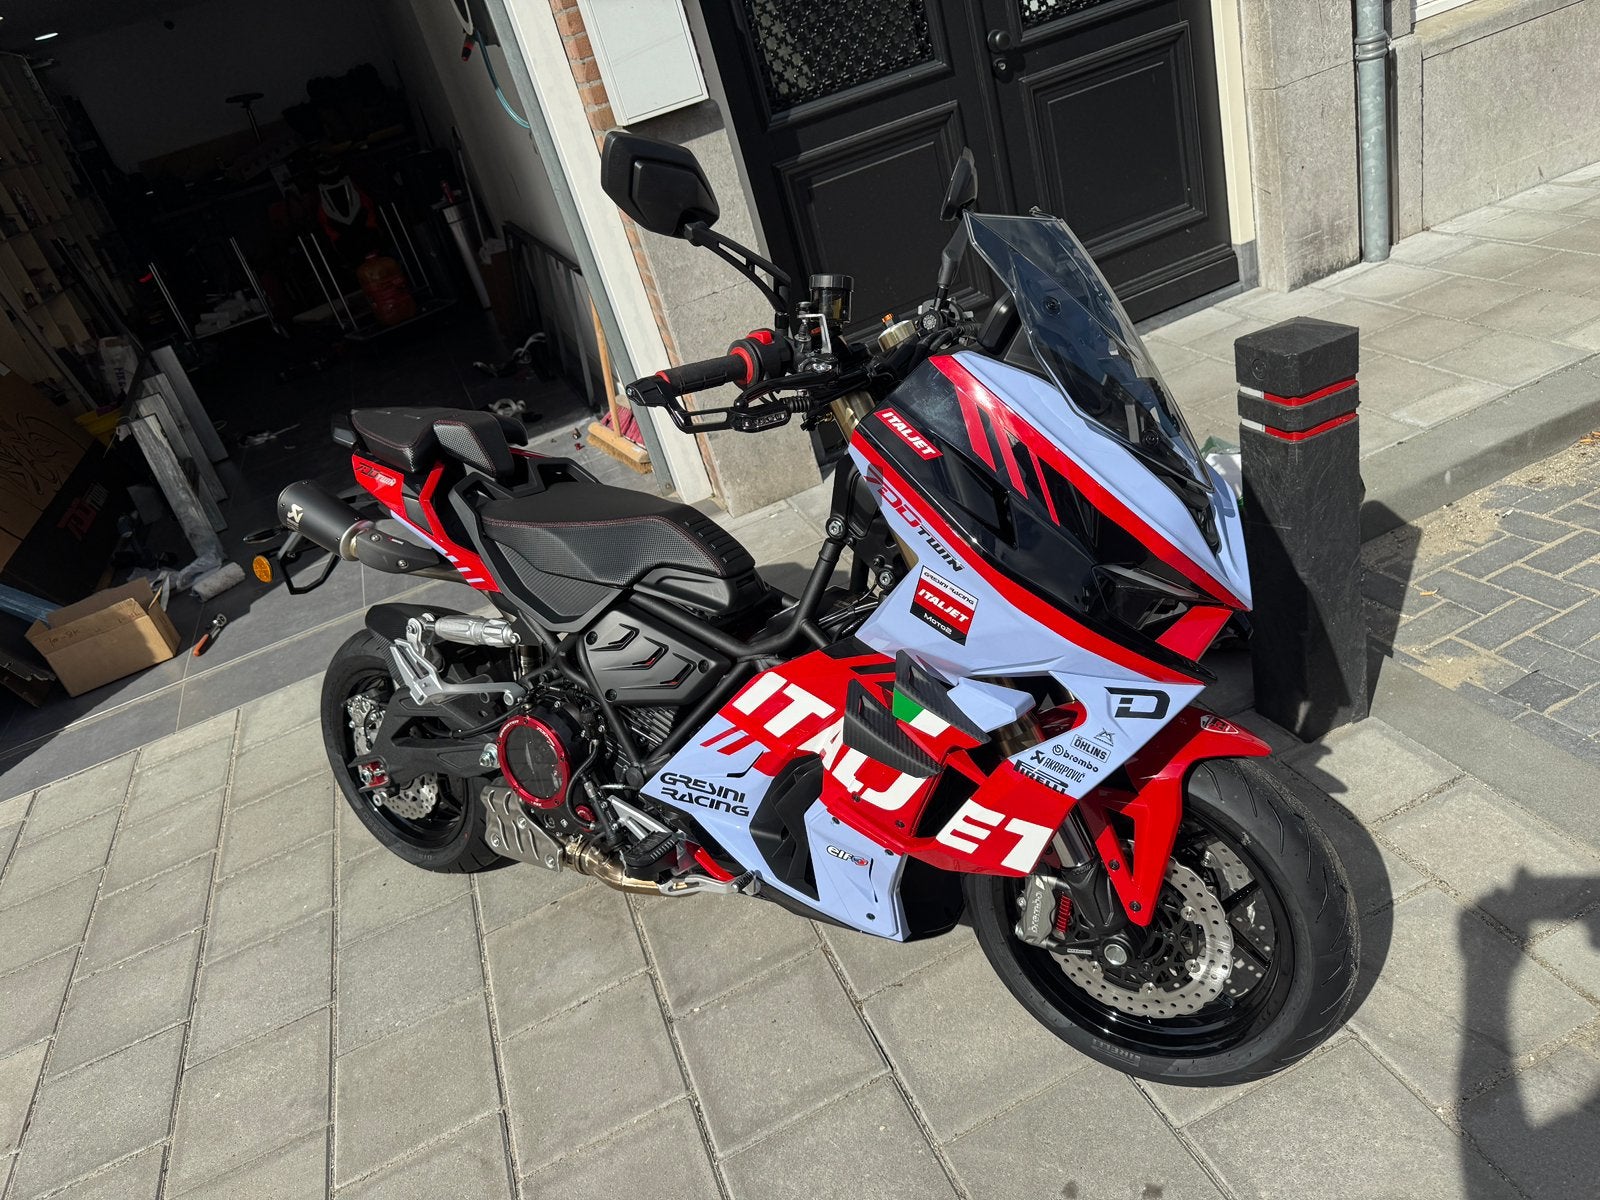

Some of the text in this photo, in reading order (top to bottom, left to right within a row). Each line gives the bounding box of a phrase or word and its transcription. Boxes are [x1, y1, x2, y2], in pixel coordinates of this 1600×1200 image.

[881, 411, 937, 456] ITALJET
[923, 571, 975, 606] GRESINI RACING
[917, 588, 969, 623] ITALJET
[1073, 737, 1108, 760] ÖHLINS
[660, 772, 745, 804] GRESINI
[1013, 759, 1069, 795] PIRELLI
[661, 786, 749, 818] RACING
[826, 845, 853, 861] elf
[1090, 1038, 1141, 1067] PIRELLI
